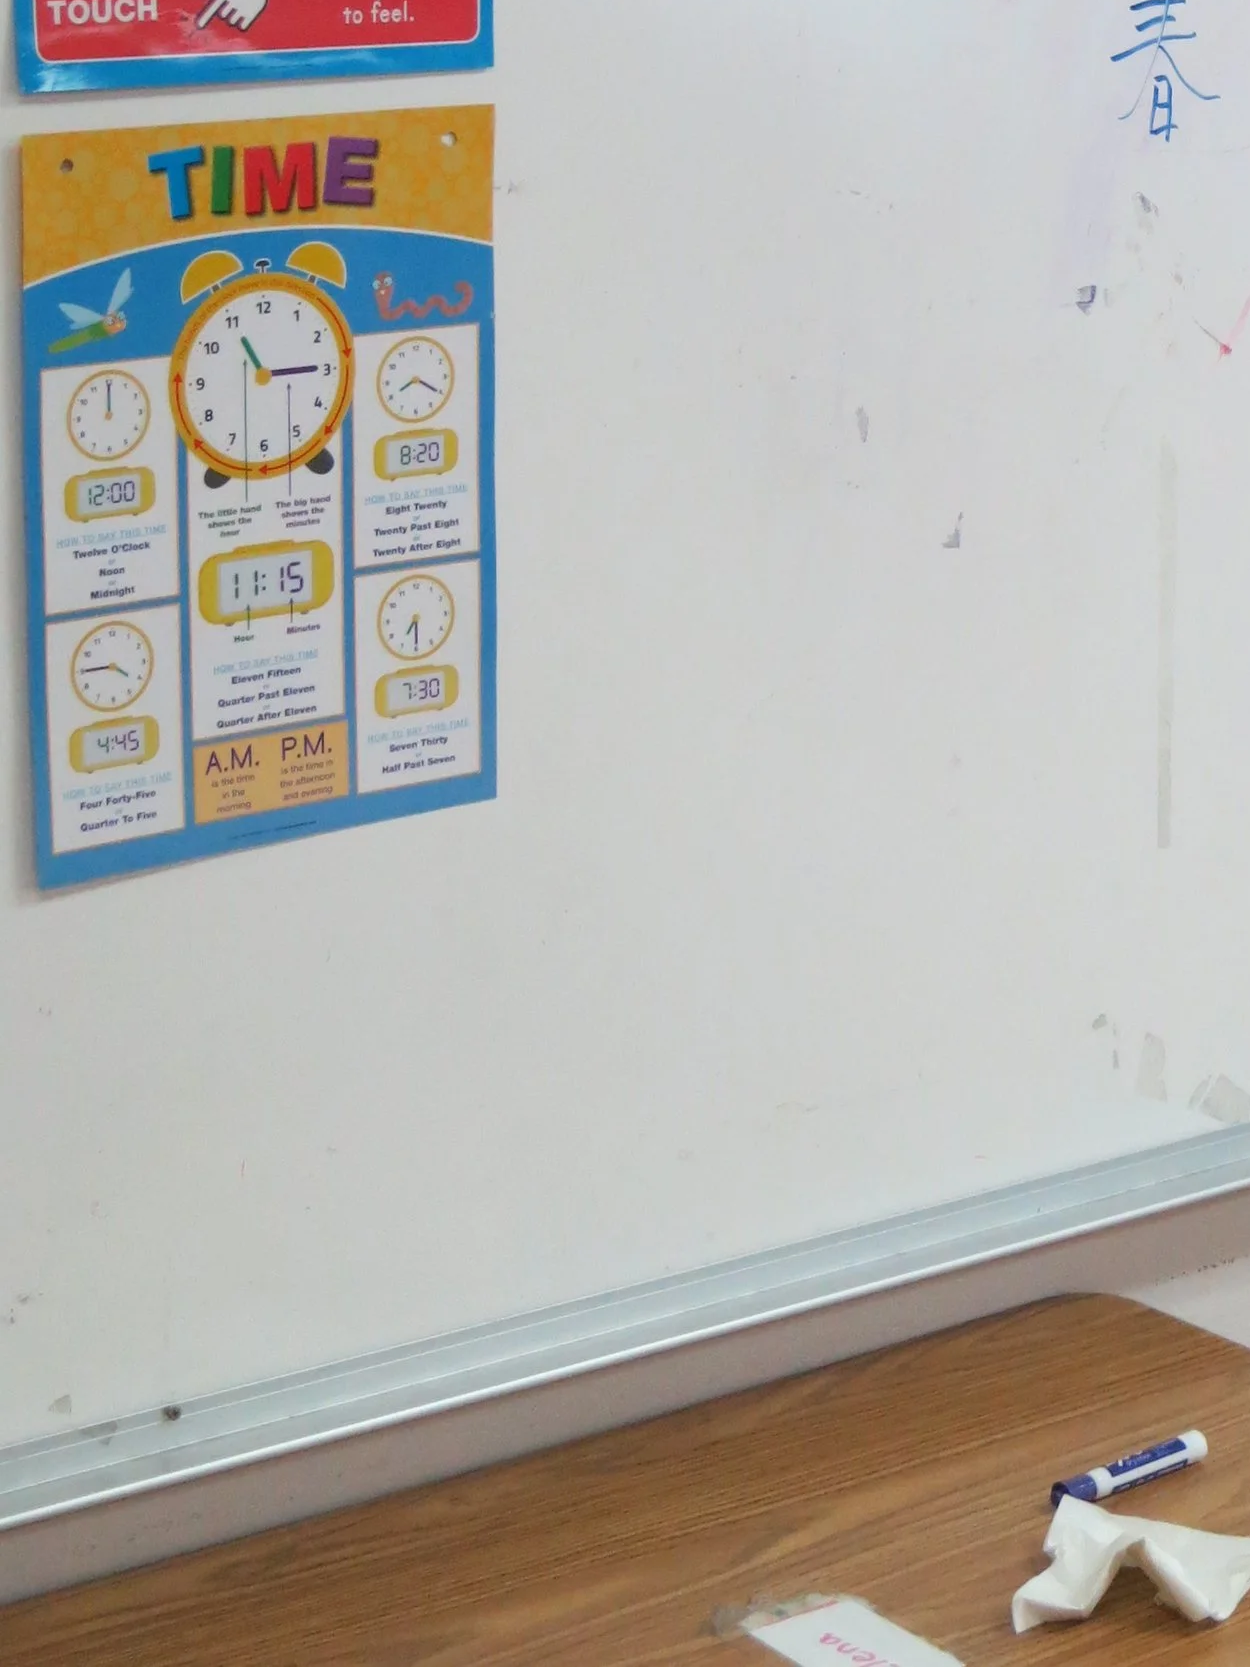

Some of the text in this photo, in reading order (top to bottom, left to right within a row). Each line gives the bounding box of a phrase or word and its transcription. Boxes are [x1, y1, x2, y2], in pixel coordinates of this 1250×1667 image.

[343, 3, 415, 24] to feel.
[148, 136, 379, 220] TIME
[256, 301, 271, 314] 12
[293, 309, 300, 322] 1
[225, 316, 239, 329] 11
[313, 330, 321, 343] 2
[203, 341, 220, 355] 10
[323, 363, 331, 376] 3
[196, 377, 205, 390] 9
[314, 396, 323, 408] 4
[204, 409, 214, 422] 8
[292, 425, 301, 437] 5
[228, 433, 236, 445] 7
[260, 439, 269, 452] 6
[400, 442, 440, 465] 8:20
[88, 480, 135, 506] 12:00
[402, 678, 440, 700] 7:30
[97, 730, 140, 754] 4:45
[281, 731, 333, 762] P.M.
[205, 744, 260, 776] A.M.
